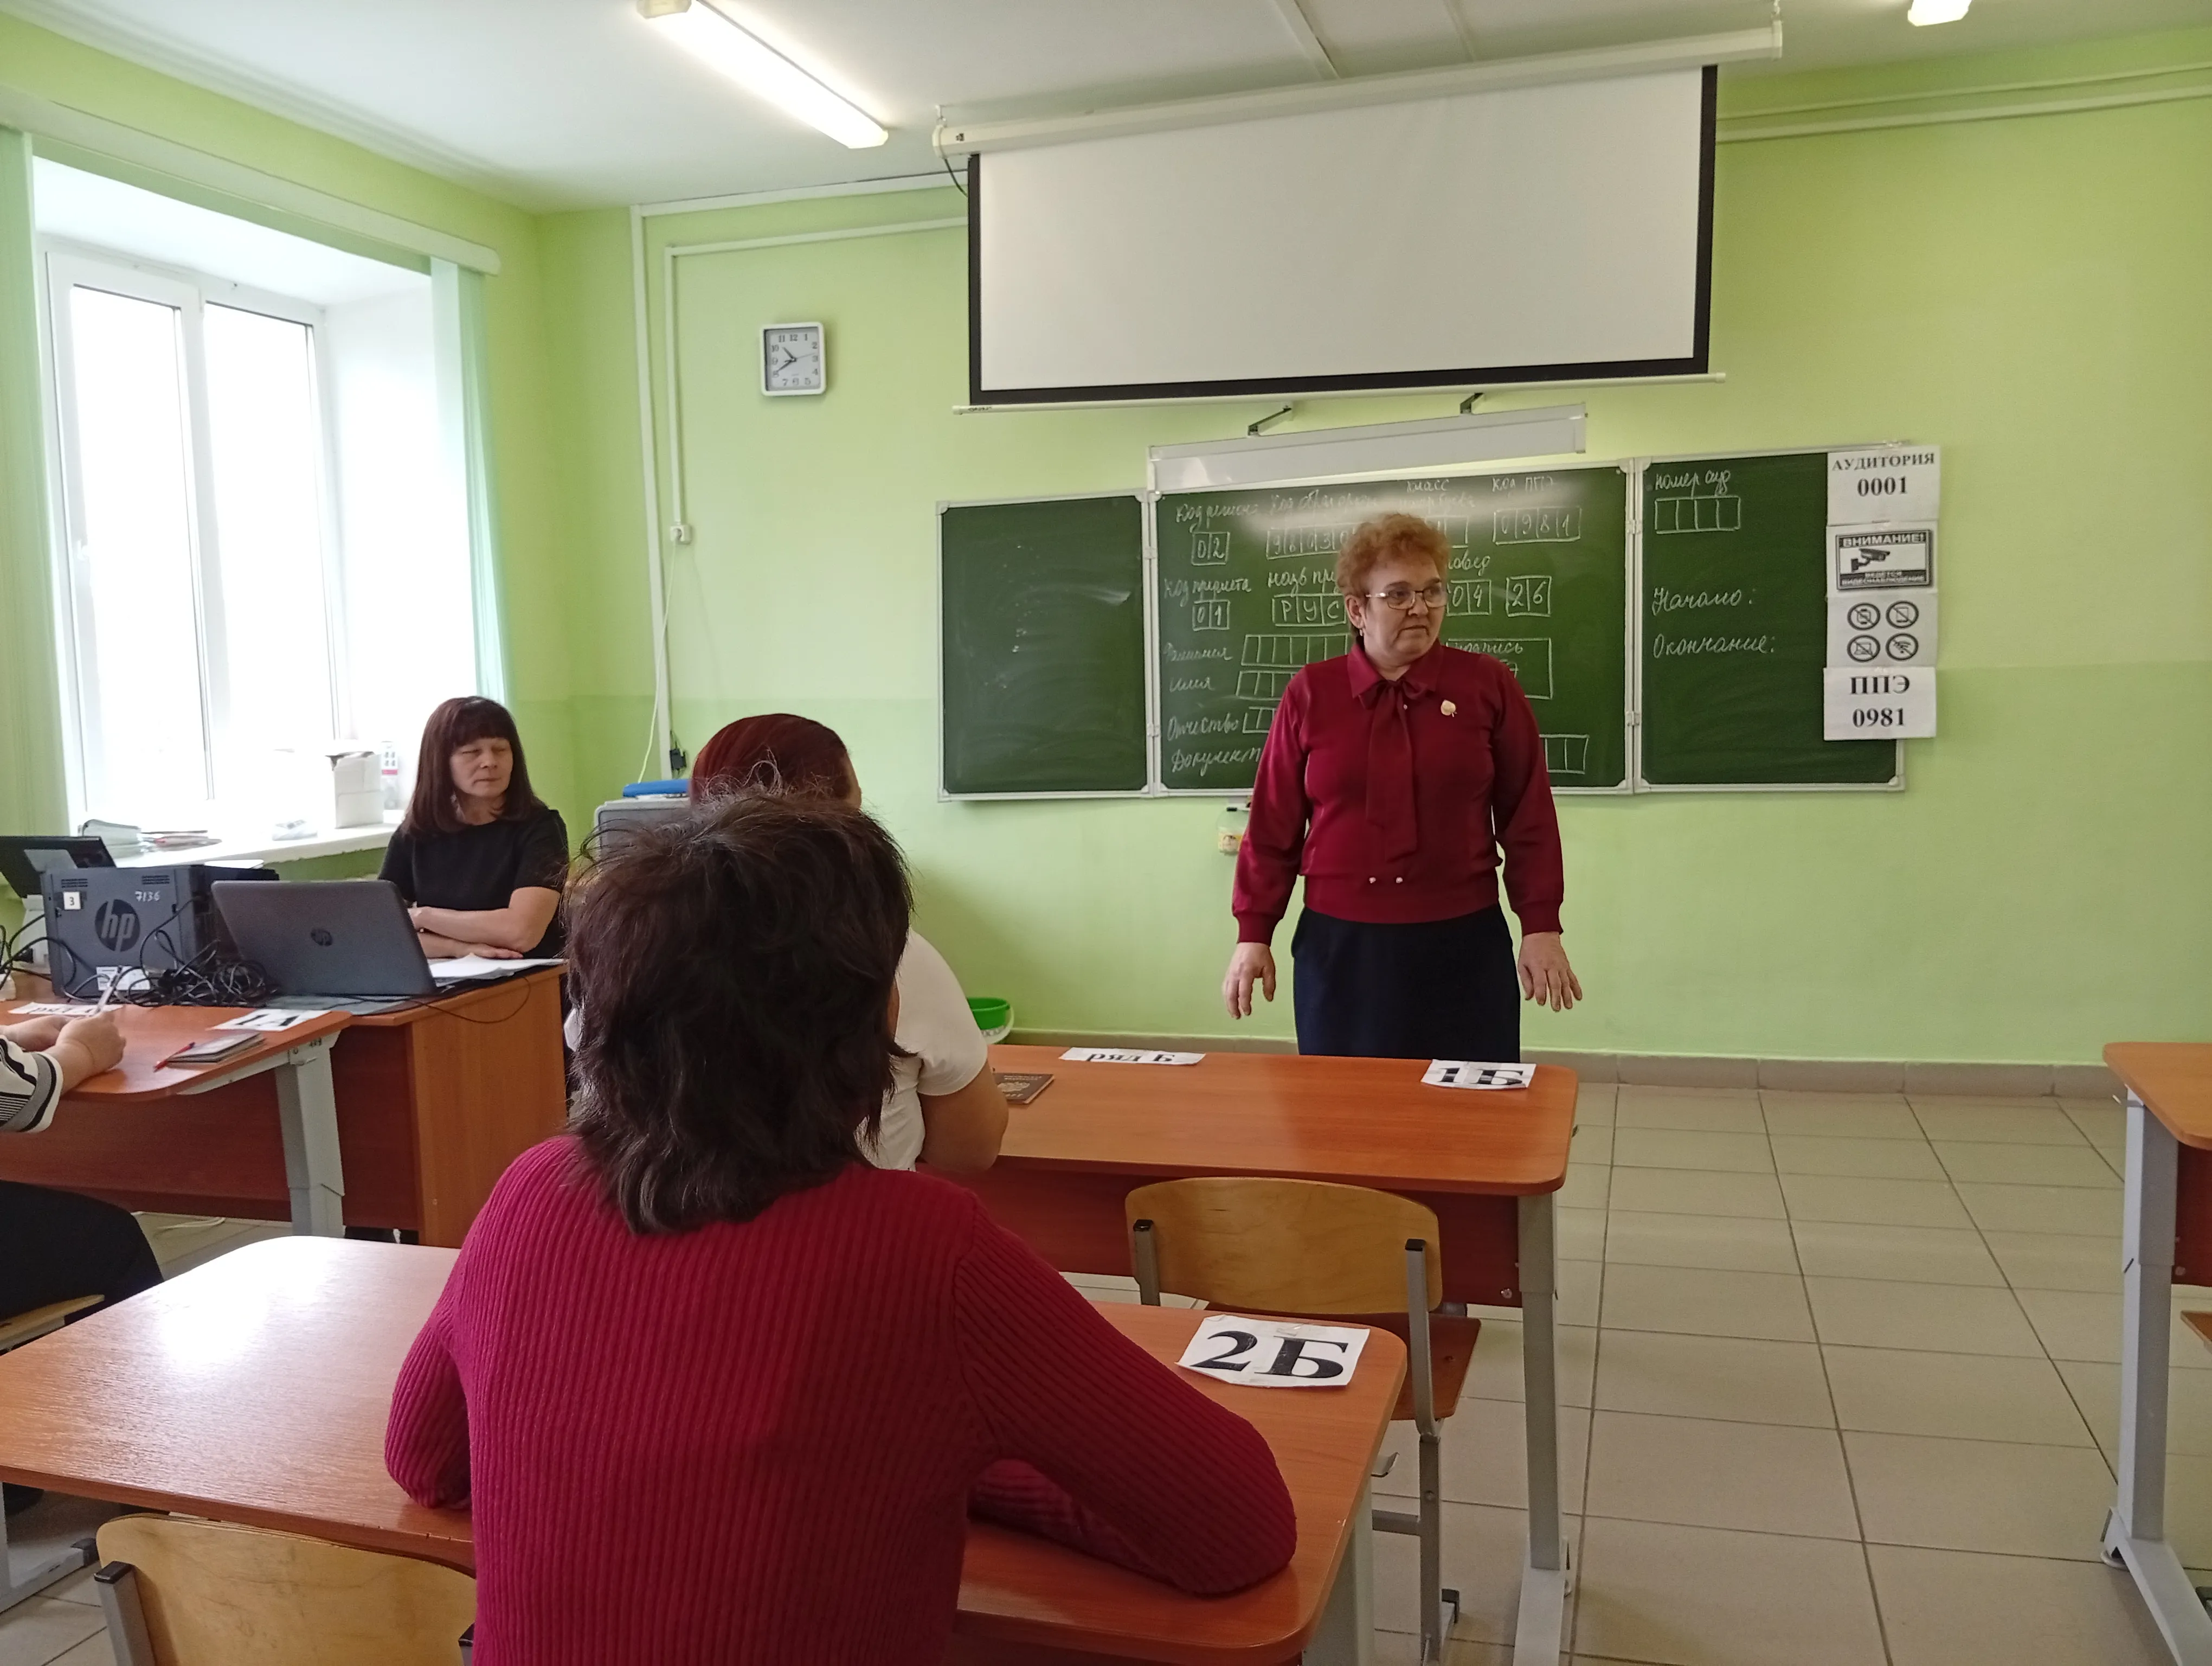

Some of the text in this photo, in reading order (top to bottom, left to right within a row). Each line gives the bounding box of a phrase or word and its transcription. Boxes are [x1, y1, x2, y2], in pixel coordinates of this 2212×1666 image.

[1832, 452, 1935, 471] АУДИТОРИЯ
[1857, 476, 1907, 497] 0001
[1843, 533, 1924, 547] ВНИМАНИЕ!
[1850, 675, 1910, 695] ППЭ
[1853, 707, 1905, 727] 0981
[69, 896, 75, 906] 3
[101, 899, 136, 952] hp
[1189, 1330, 1348, 1379] 2Б
